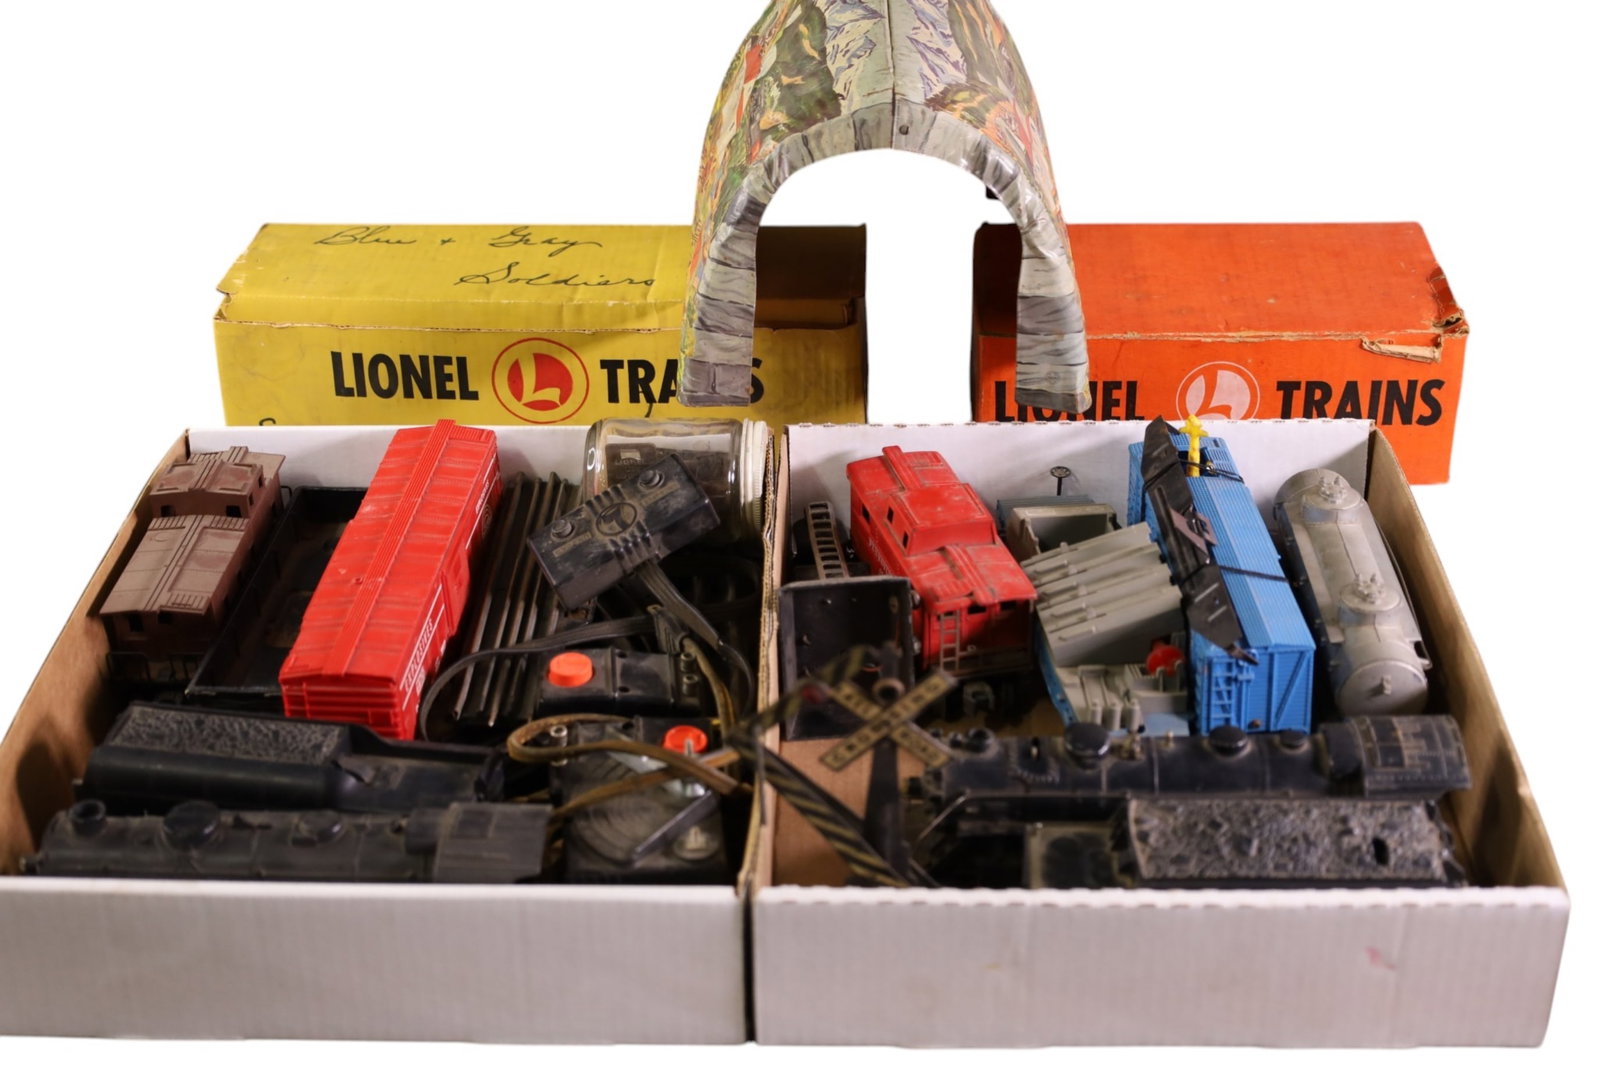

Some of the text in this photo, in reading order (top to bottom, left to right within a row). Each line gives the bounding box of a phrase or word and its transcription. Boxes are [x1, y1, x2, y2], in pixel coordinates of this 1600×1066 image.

[314, 226, 417, 246] Blue
[488, 225, 603, 257] Gray
[453, 261, 656, 287] Soldiers
[330, 350, 480, 401] LIONEL
[599, 357, 765, 404] TRAS
[1276, 378, 1446, 427] TRAINS
